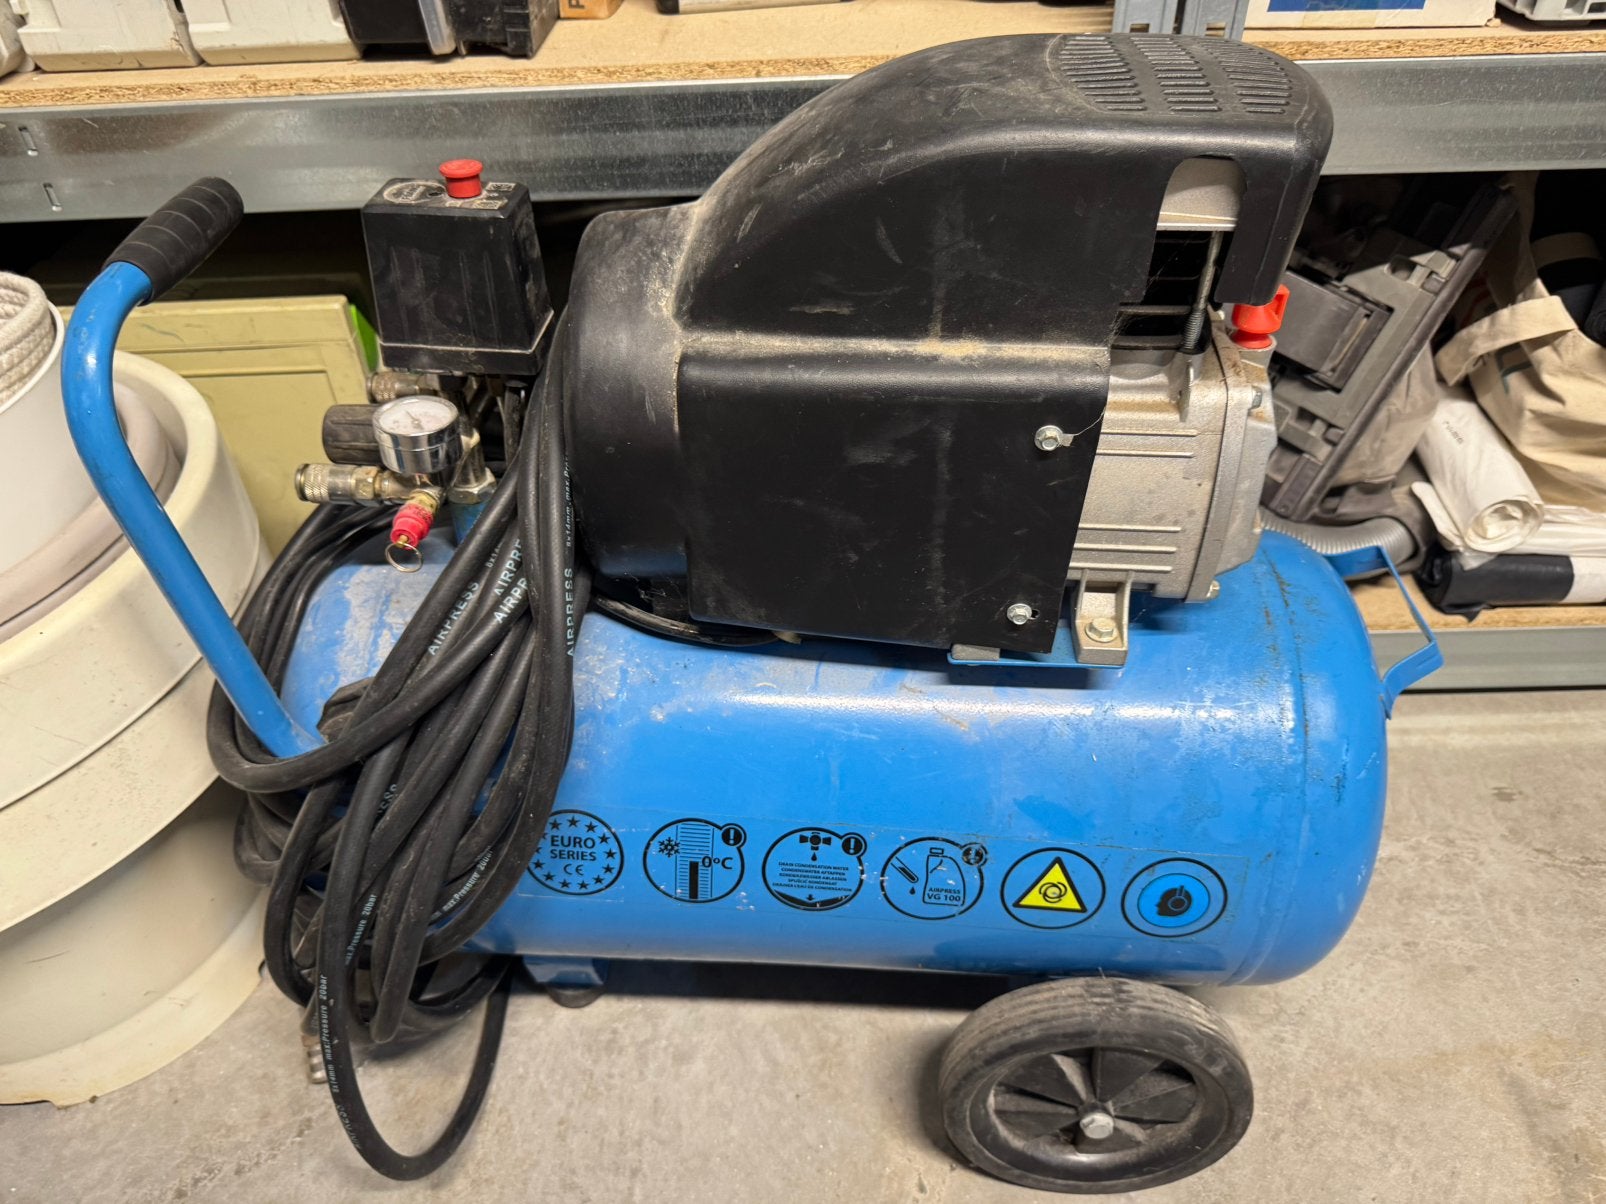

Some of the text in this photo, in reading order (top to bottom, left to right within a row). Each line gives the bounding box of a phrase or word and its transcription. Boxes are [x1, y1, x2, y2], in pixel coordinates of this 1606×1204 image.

[565, 568, 574, 656] AIRPRESS
[428, 582, 480, 656] AIRPRESS
[551, 835, 596, 849] EURO
[550, 849, 597, 861] SERIES
[563, 863, 584, 876] CE
[927, 892, 961, 902] VG 100
[928, 887, 961, 895] AIRPRESS
